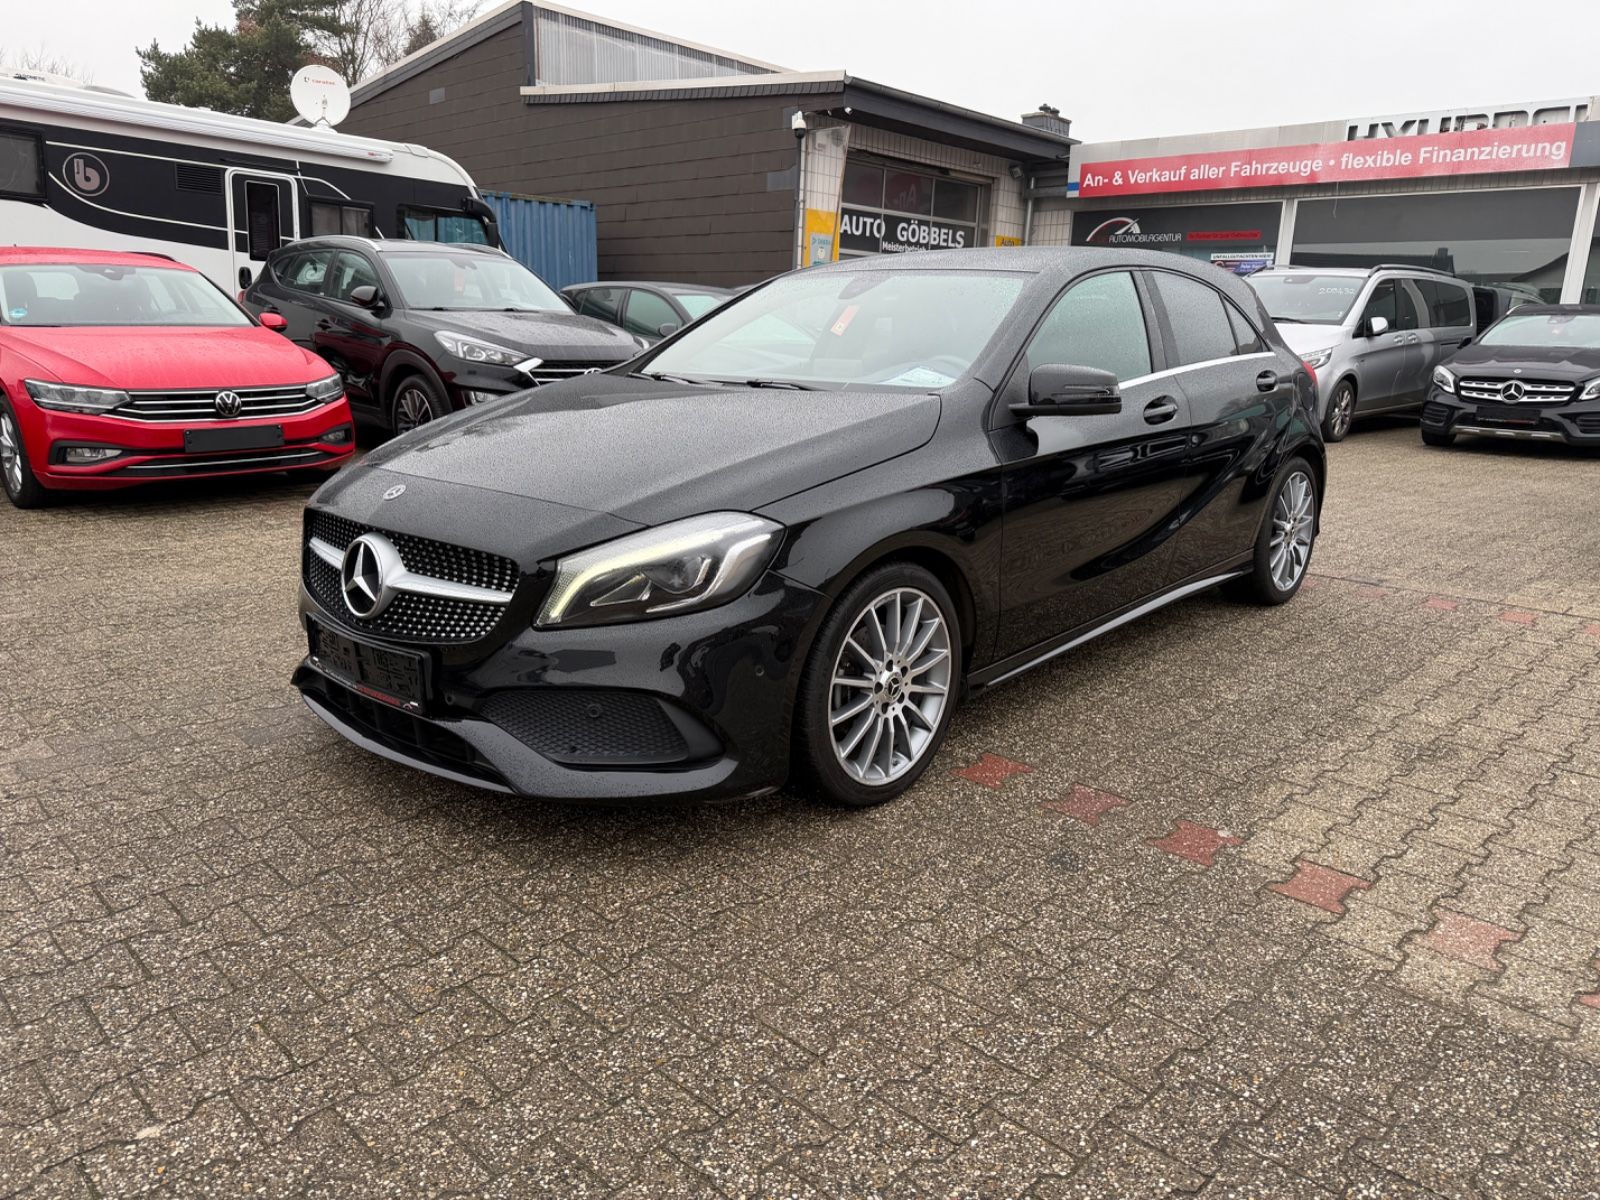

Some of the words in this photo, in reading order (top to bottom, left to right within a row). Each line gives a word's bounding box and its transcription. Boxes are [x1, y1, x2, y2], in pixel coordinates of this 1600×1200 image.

[1083, 173, 1108, 188] An-
[1112, 170, 1123, 186] &
[1127, 166, 1187, 185] Verkauf
[1189, 163, 1226, 180] aller
[1230, 158, 1323, 178] Fahrzeuge
[1340, 149, 1412, 169] flexible
[1419, 140, 1566, 165] Finanzierung
[840, 214, 886, 238] AUTO
[896, 219, 965, 248] GÖBBELS
[1108, 232, 1182, 243] AUTOMOBILAGENTUR
